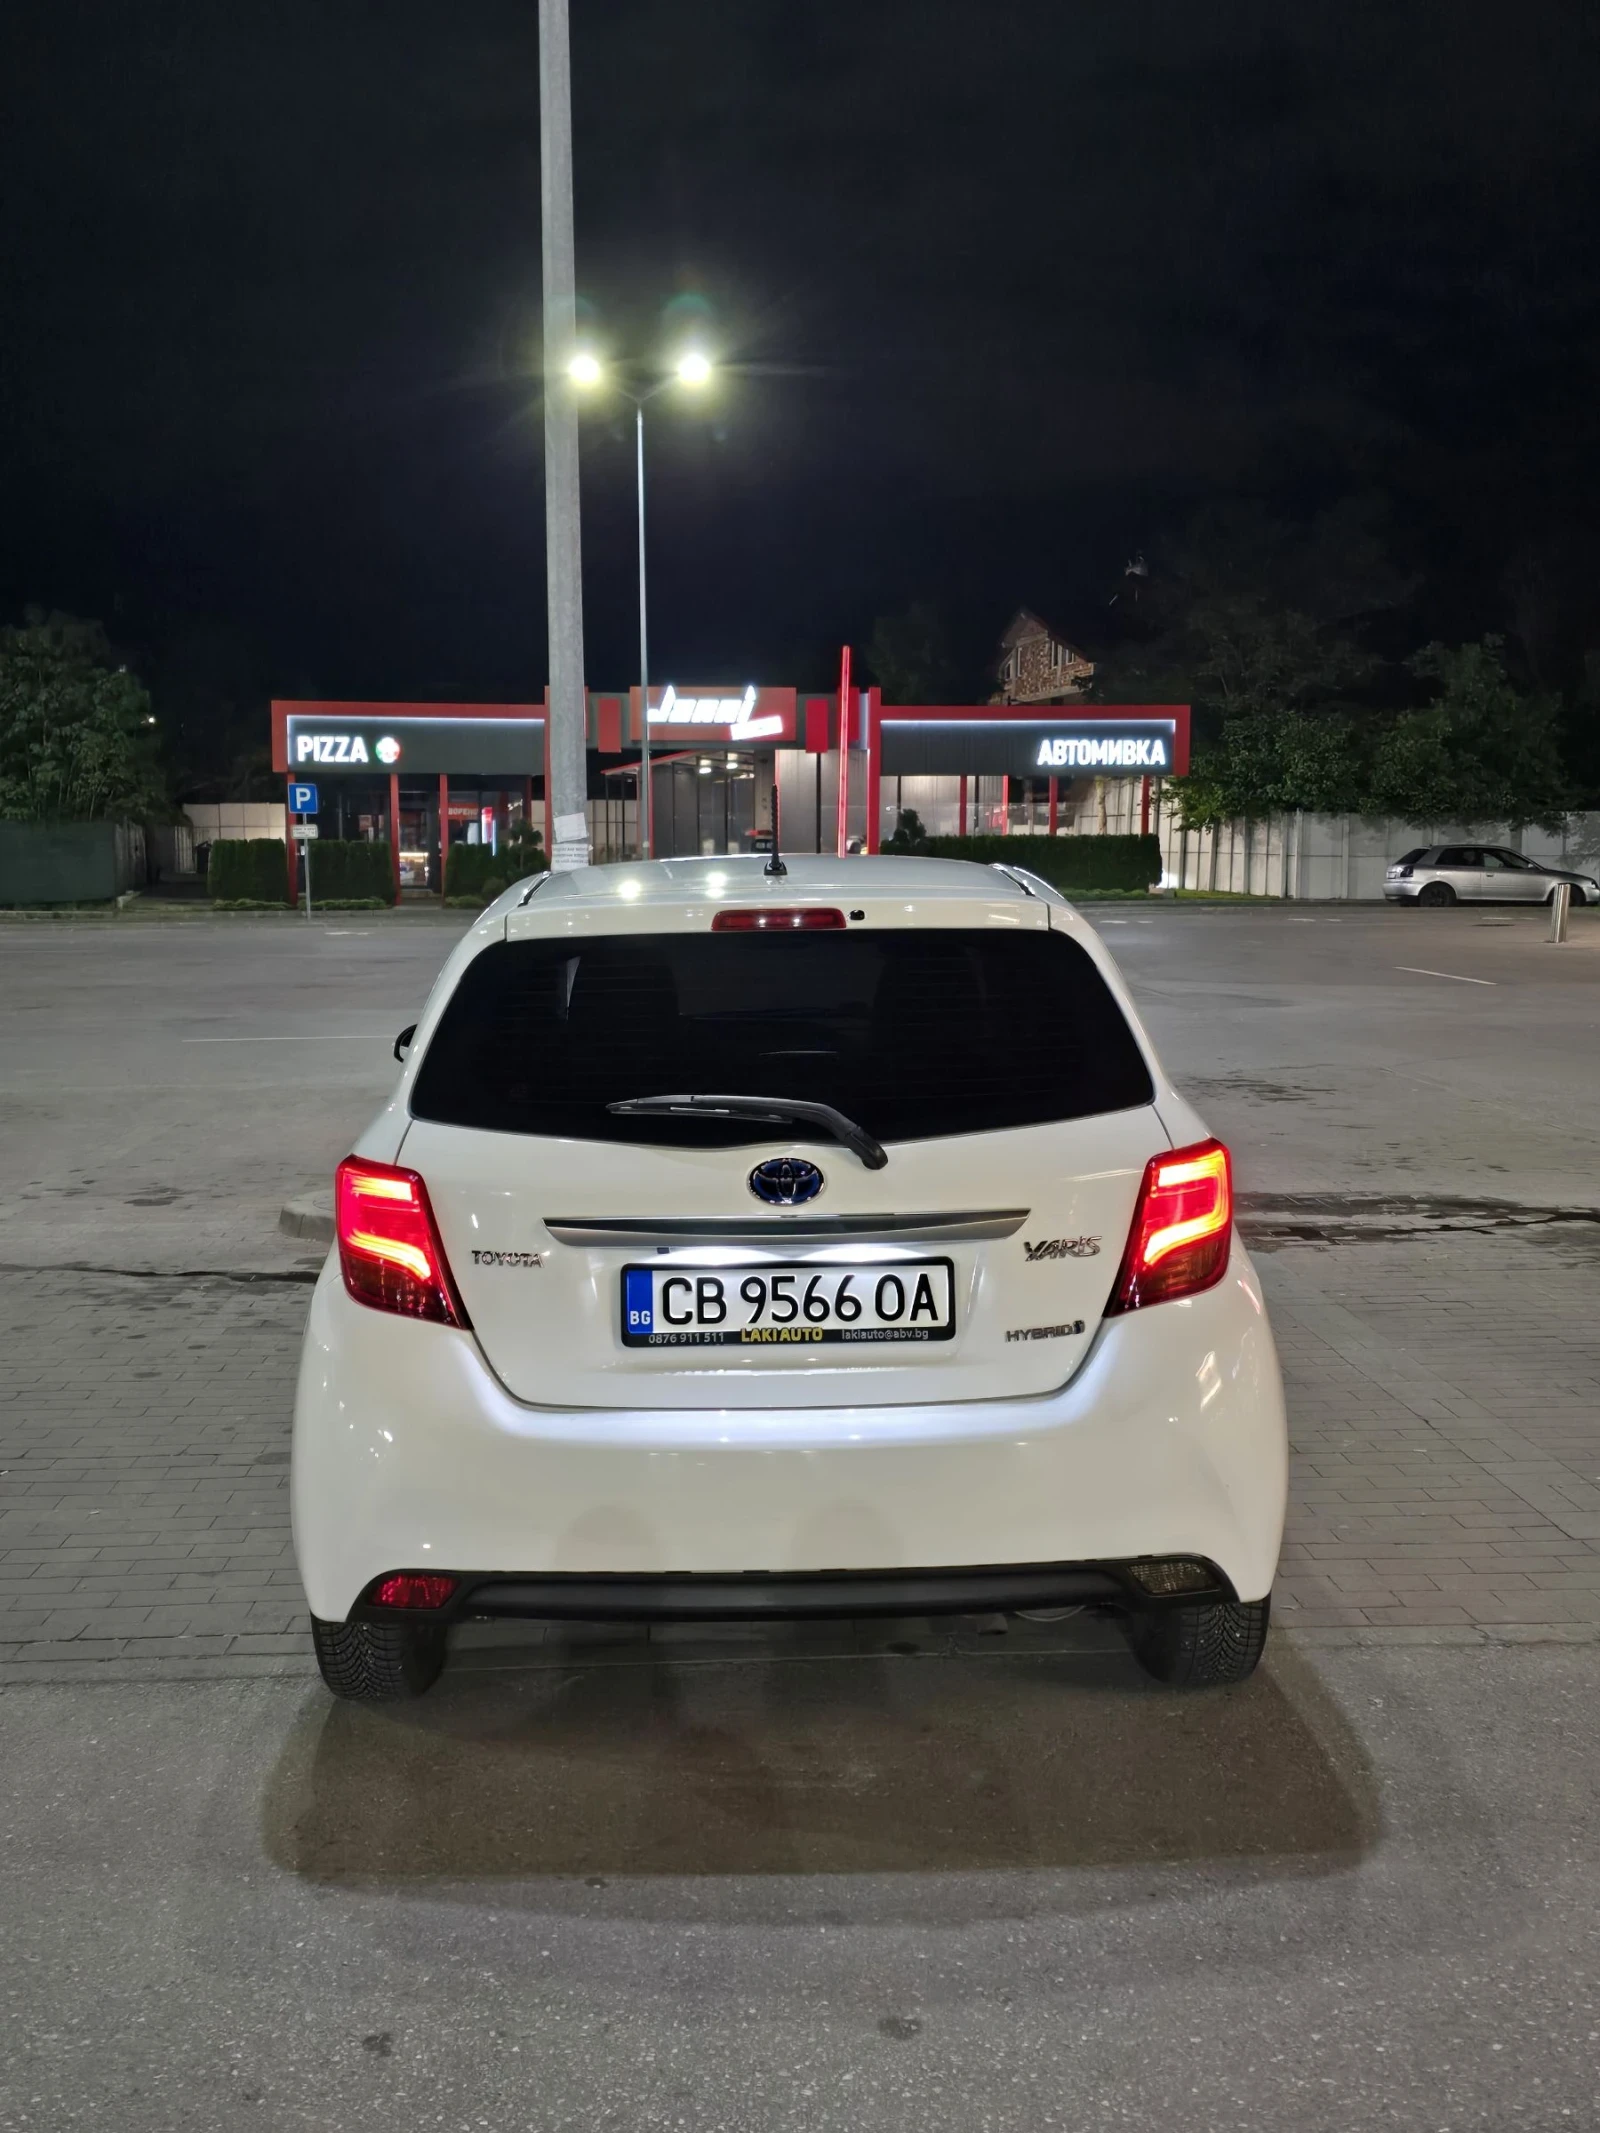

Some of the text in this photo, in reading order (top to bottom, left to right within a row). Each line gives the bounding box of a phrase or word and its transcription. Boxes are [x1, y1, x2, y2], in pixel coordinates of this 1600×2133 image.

[297, 736, 369, 763] PIZZA
[1036, 738, 1166, 766] АВТОМИВКА
[295, 787, 311, 809] P
[471, 1250, 544, 1268] TOYOTA
[1023, 1236, 1102, 1262] YARIS
[661, 1276, 727, 1325] CB
[739, 1274, 862, 1324] 9566
[630, 1310, 651, 1326] BG
[648, 1331, 724, 1344] 0876 911 511
[841, 1329, 929, 1341] lakiauto@abv.bg
[1005, 1323, 1073, 1342] HYBRID
